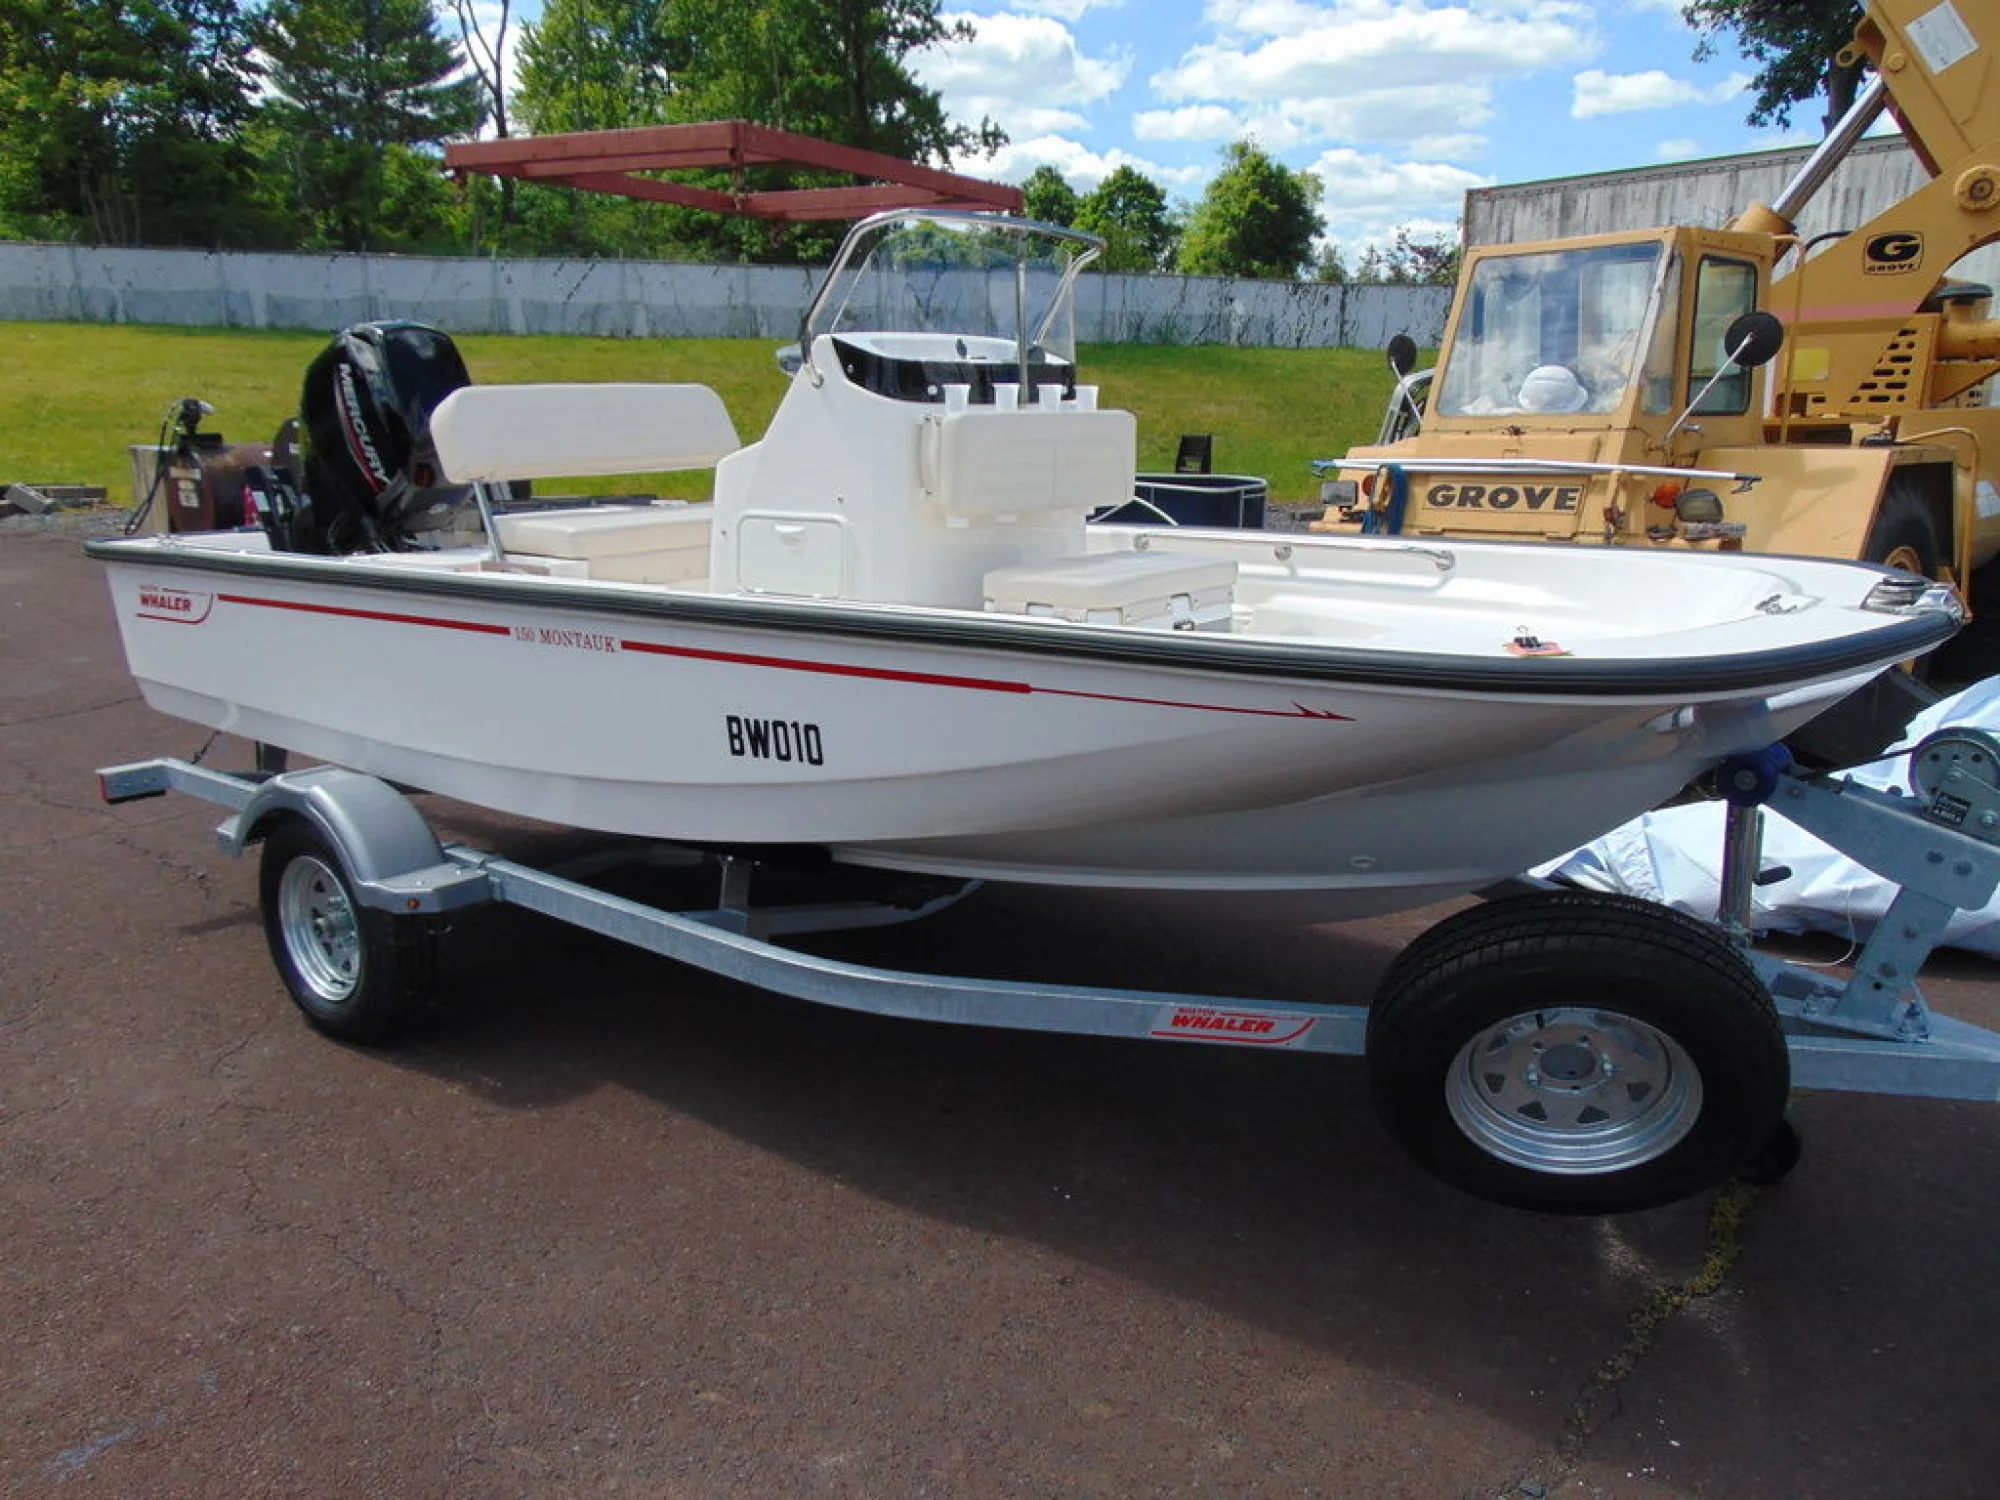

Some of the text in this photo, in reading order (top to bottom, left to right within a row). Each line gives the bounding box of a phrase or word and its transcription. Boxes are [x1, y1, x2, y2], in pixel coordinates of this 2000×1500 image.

[339, 362, 392, 485] MERCURY
[1427, 484, 1580, 511] GROVE
[139, 593, 192, 612] WHALER
[515, 626, 617, 653] 150 MONTAUK
[726, 714, 824, 766] BW010
[1171, 1015, 1276, 1034] WHALER
